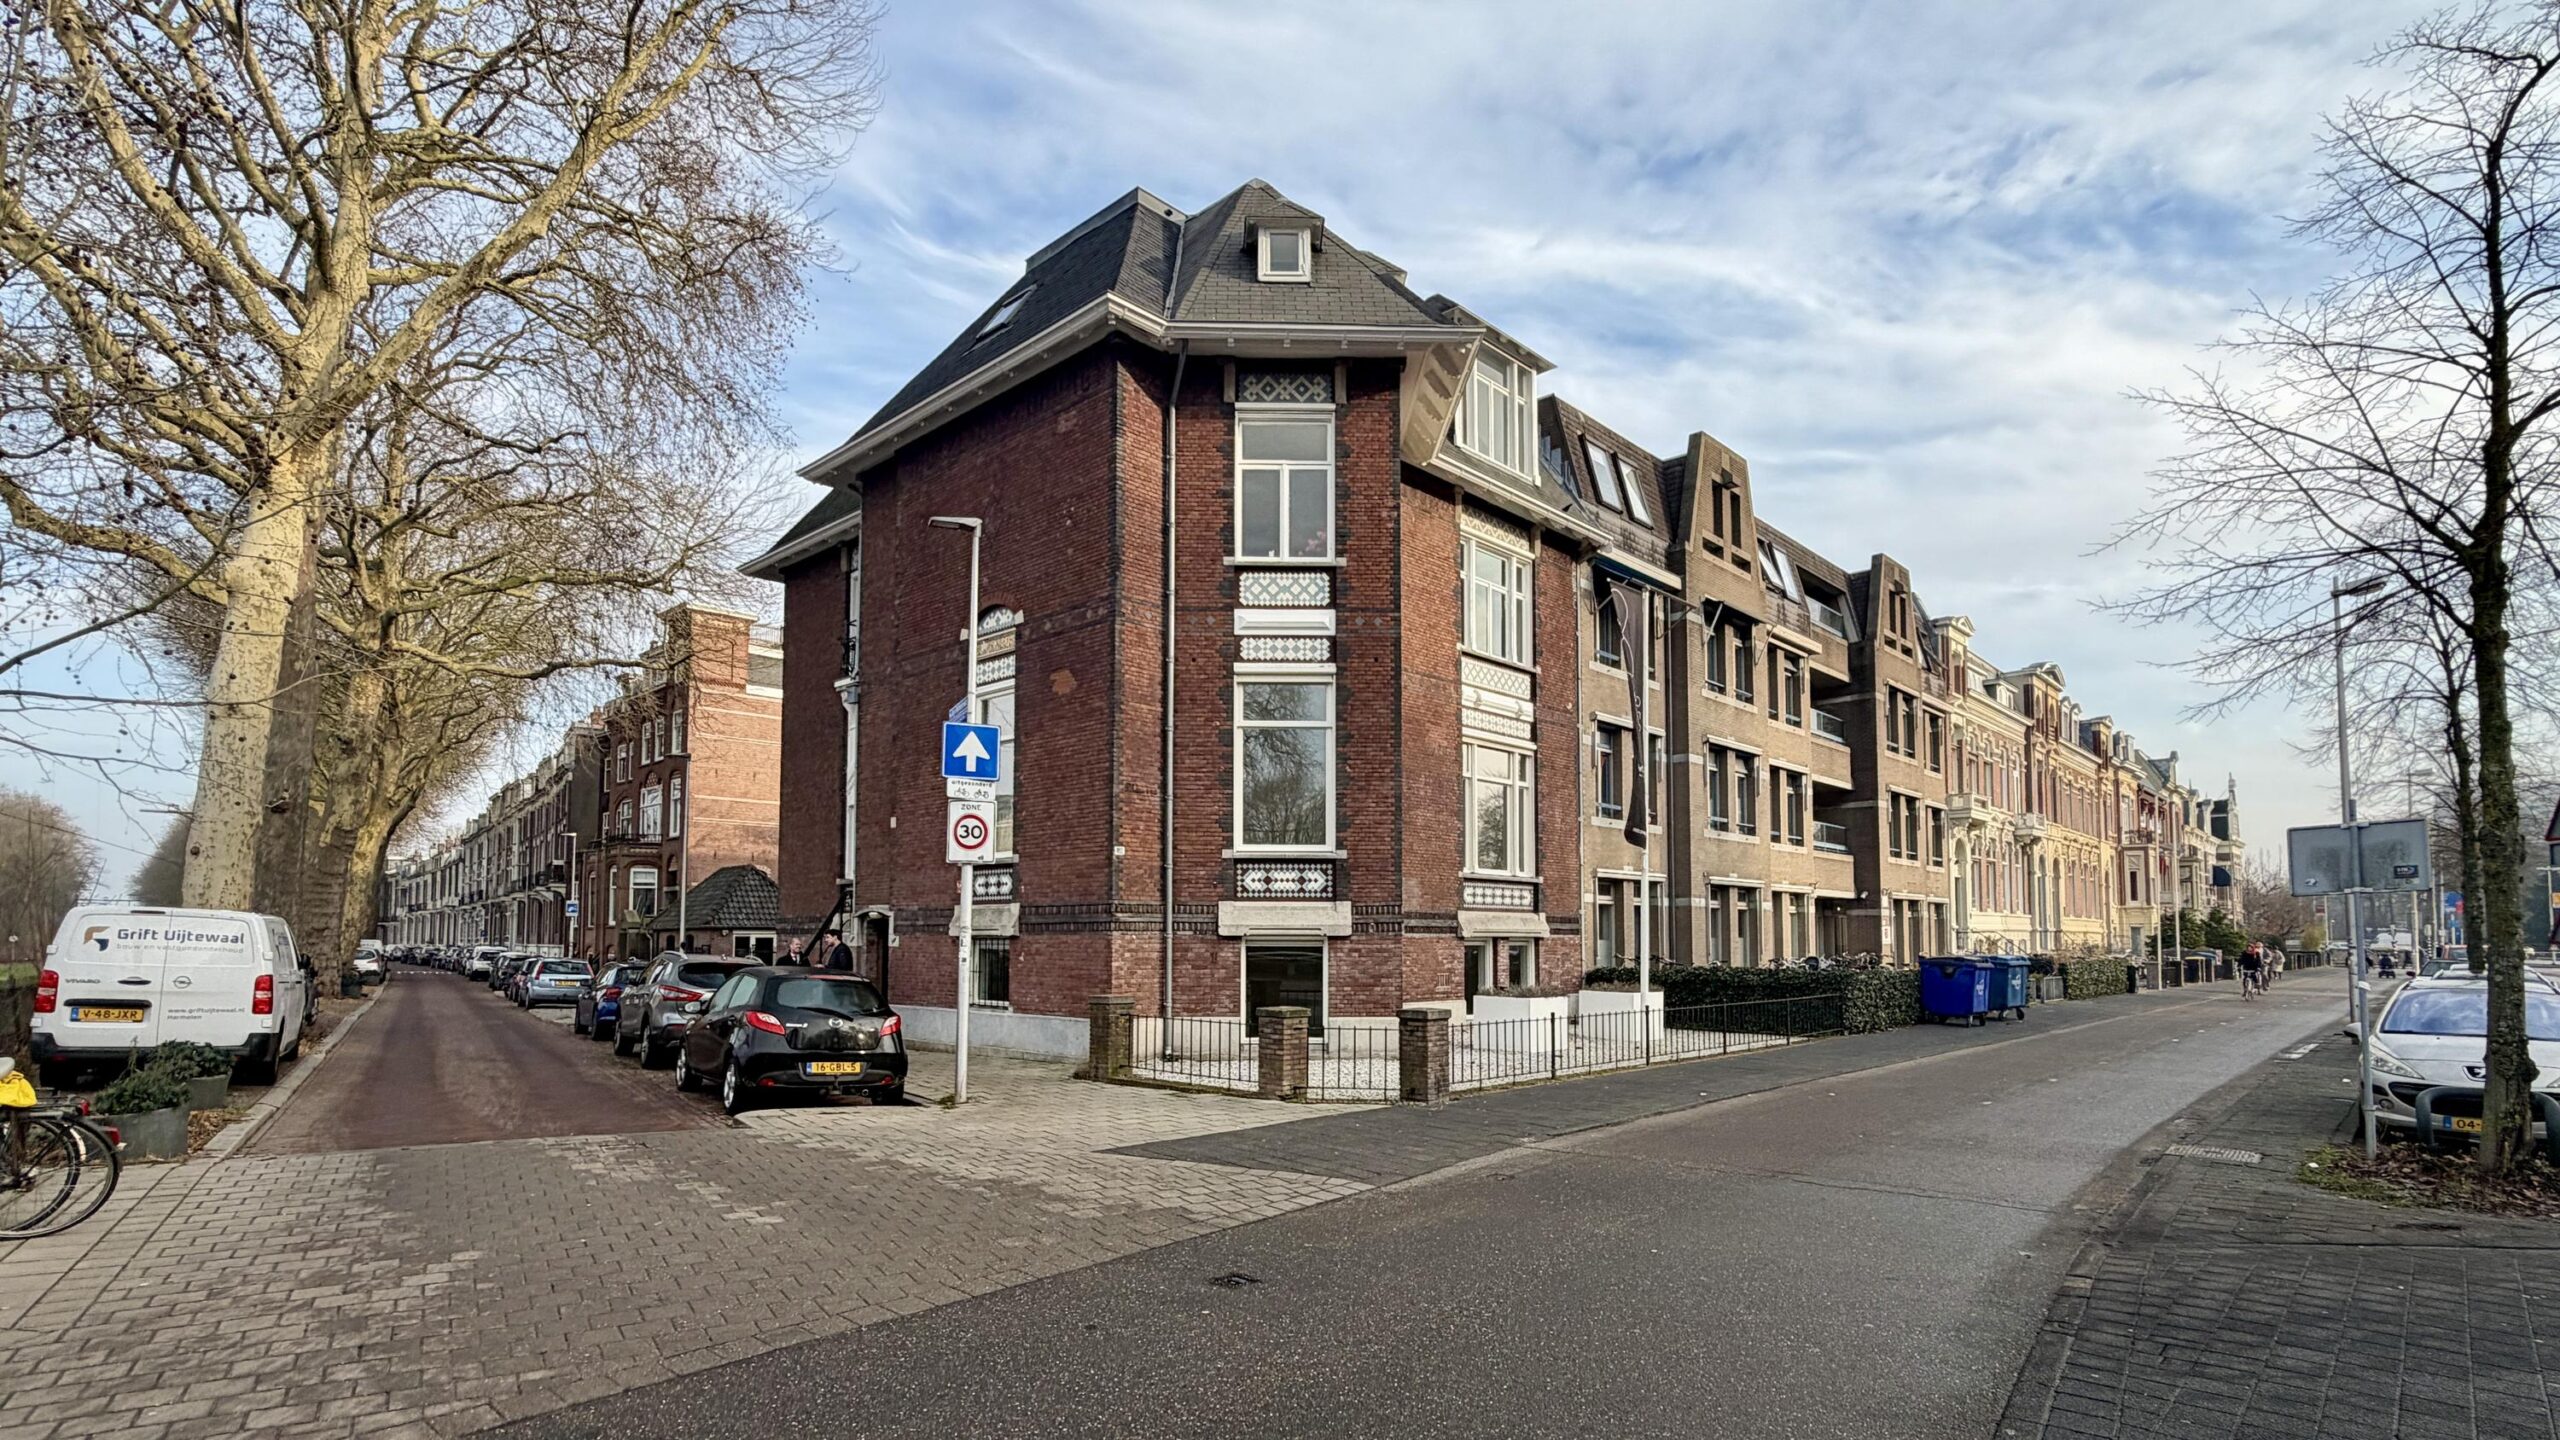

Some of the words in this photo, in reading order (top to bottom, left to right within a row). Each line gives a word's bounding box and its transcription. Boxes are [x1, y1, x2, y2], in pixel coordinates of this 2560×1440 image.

[959, 824, 983, 839] 30
[117, 928, 158, 941] Grift
[164, 929, 245, 945] Uijtewaal
[83, 1009, 138, 1019] V-48-JXR
[816, 1062, 857, 1072] 16-GBL-5
